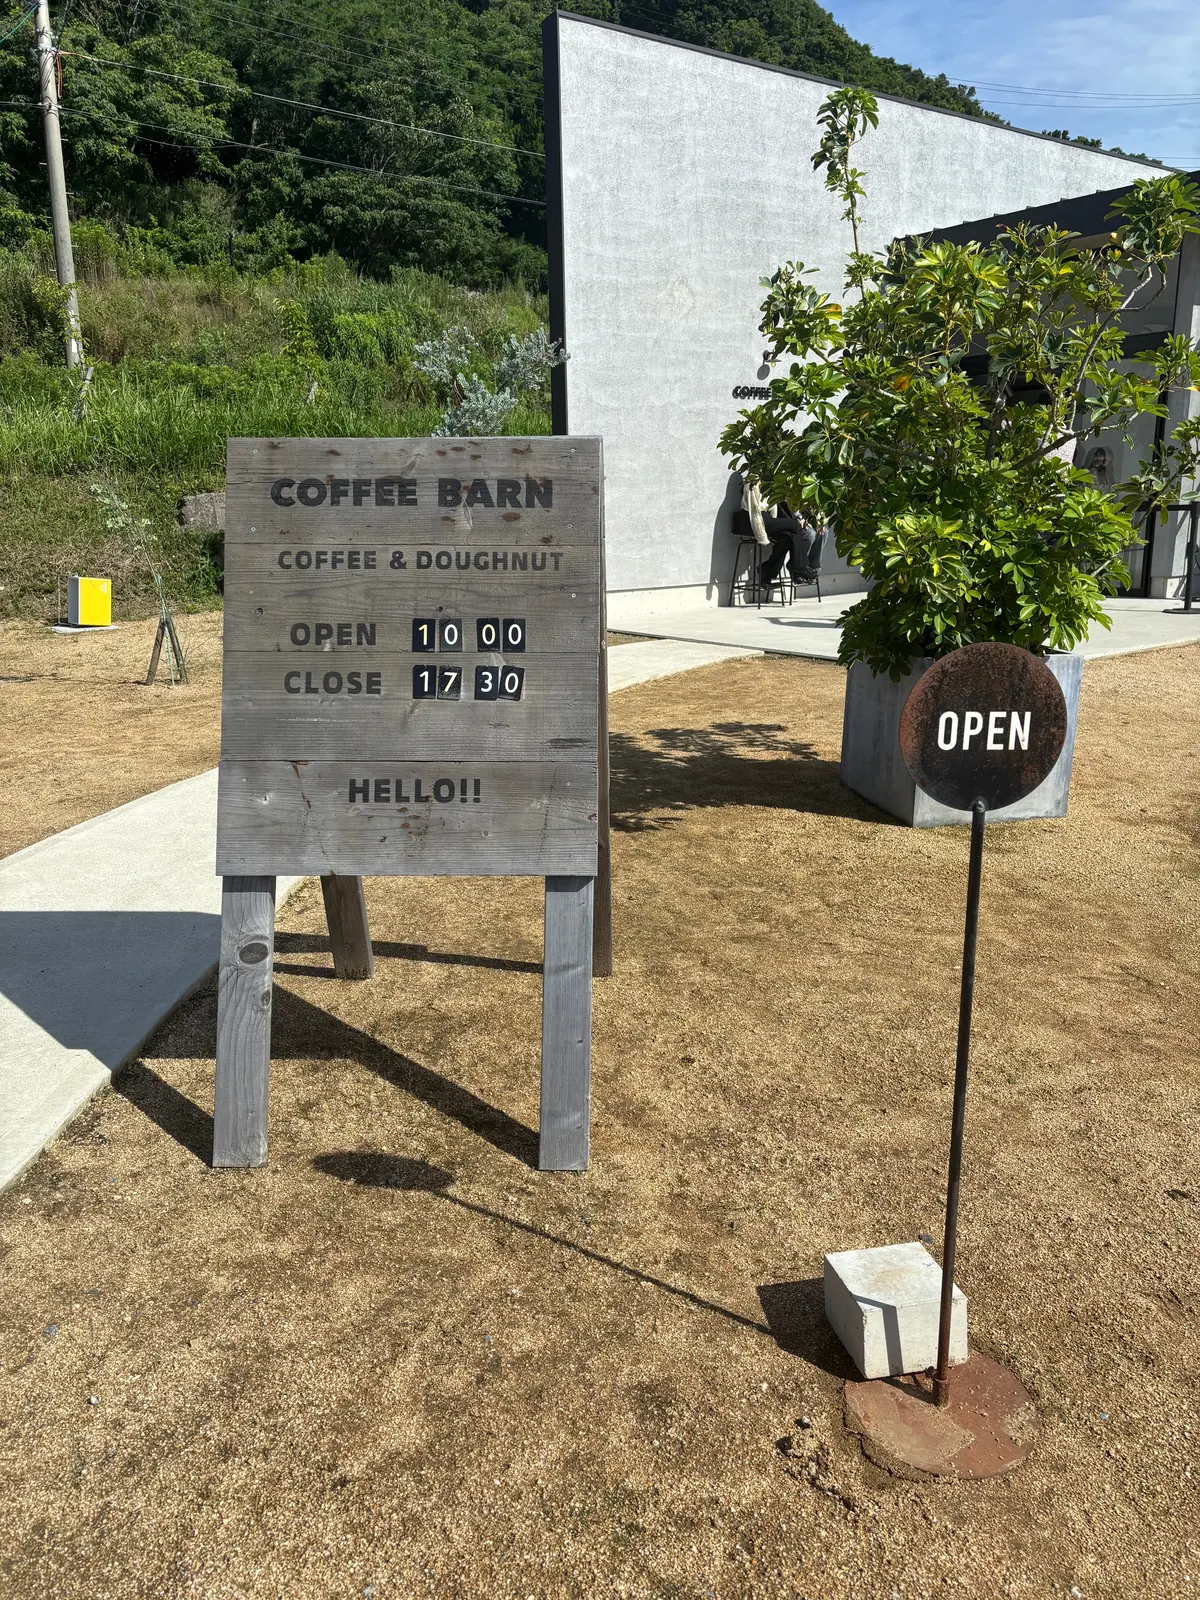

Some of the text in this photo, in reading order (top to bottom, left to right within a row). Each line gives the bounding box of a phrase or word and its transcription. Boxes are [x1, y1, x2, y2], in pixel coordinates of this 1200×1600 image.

[732, 386, 771, 399] COFFEE
[270, 478, 554, 508] COFFEE BARN
[278, 550, 564, 571] COFFEE & DOUGHNUT
[289, 622, 377, 646] OPEN
[283, 671, 382, 694] CLOSE
[937, 711, 1031, 750] OPEN
[348, 779, 482, 803] HELLO!!
